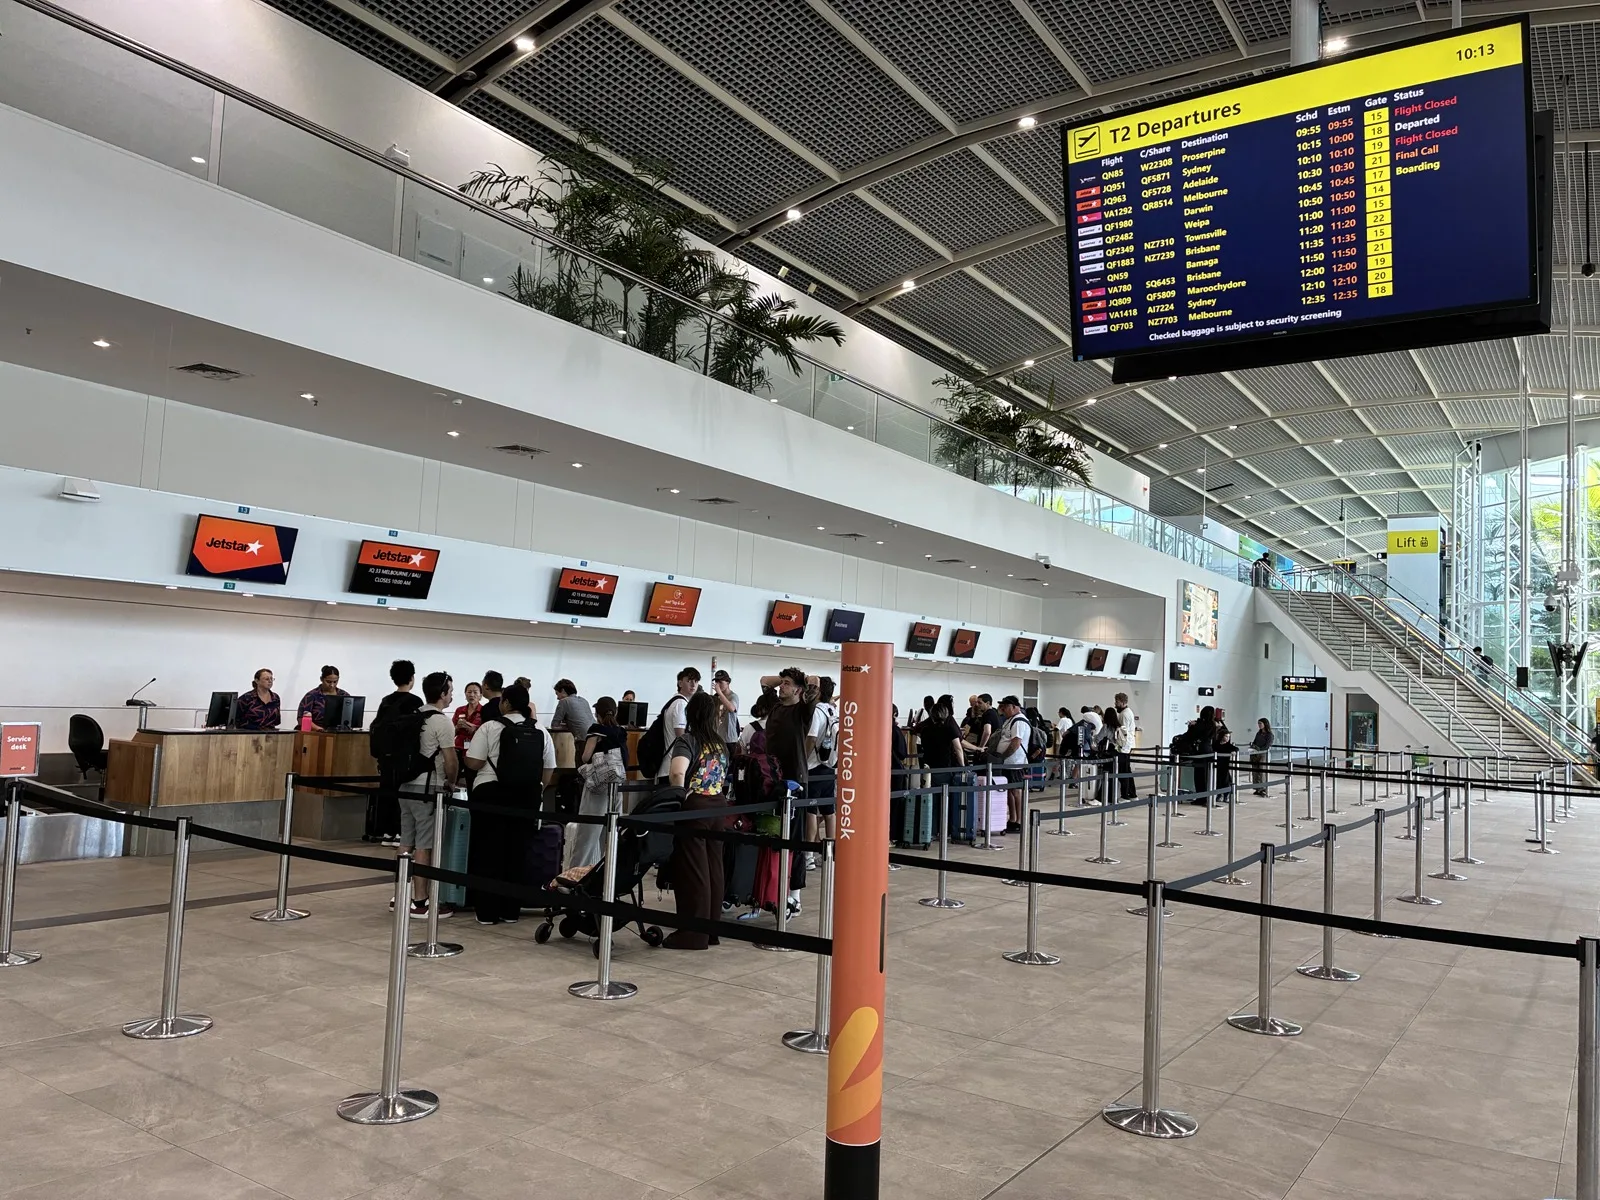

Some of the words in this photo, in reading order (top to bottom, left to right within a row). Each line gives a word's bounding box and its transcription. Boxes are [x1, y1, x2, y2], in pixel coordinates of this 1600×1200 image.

[1456, 43, 1495, 61] 10:13
[1101, 155, 1123, 167] Flight
[1139, 145, 1170, 158] C/Share
[1181, 132, 1228, 148] Destination
[1295, 110, 1317, 122] Schd
[1327, 104, 1350, 115] Estm
[1364, 96, 1387, 107] Gate
[1393, 88, 1424, 101] Status
[1101, 168, 1123, 180] QN85
[1140, 157, 1172, 171] W22308
[1181, 147, 1225, 162] Proserpine
[1295, 124, 1321, 137] 09:55
[1327, 117, 1353, 130] 09:55
[1371, 112, 1382, 121] 15
[1394, 103, 1422, 117] Flight
[1424, 96, 1457, 111] Closed
[1110, 126, 1131, 143] T2
[1137, 103, 1241, 138] Departures
[1102, 181, 1125, 193] JQ951
[1140, 171, 1169, 184] QF5871
[1182, 163, 1212, 177] Sydney
[1296, 138, 1321, 151] 10:15
[1328, 132, 1354, 144] 10:00
[1371, 126, 1382, 136] 18
[1394, 114, 1440, 131] Departed
[1102, 194, 1126, 205] JQ963
[1141, 184, 1171, 197] QF5728
[1182, 175, 1218, 189] Adelaide
[1297, 153, 1321, 165] 10:10
[1328, 146, 1354, 158] 10:10
[1372, 141, 1383, 150] 19
[1395, 133, 1423, 147] Flight
[1425, 126, 1458, 140] Closed
[1103, 206, 1132, 218] VA1292
[1141, 197, 1173, 211] QR8514
[1183, 188, 1228, 202] Melbourne
[1297, 167, 1322, 179] 10:30
[1329, 161, 1354, 173] 10:30
[1372, 155, 1383, 164] 21
[1395, 148, 1418, 161] Final
[1420, 144, 1439, 156] Call
[1104, 219, 1133, 231] QF1980
[1183, 203, 1213, 216] Darwin
[1297, 181, 1322, 193] 10:45
[1329, 175, 1354, 187] 10:45
[1372, 170, 1383, 179] 17
[1395, 161, 1440, 175] Boarding
[1104, 231, 1133, 244] QF2482
[1183, 218, 1209, 230] Weipa
[1298, 196, 1323, 207] 10:50
[1330, 190, 1355, 201] 10:50
[1373, 184, 1384, 194] 14
[1105, 244, 1134, 256] QF2349
[1143, 237, 1174, 249] NZ7310
[1184, 228, 1226, 242] Townsville
[1298, 210, 1323, 221] 11:00
[1330, 204, 1355, 215] 11:00
[1373, 199, 1384, 208] 15
[1106, 257, 1134, 269] QF1883
[1144, 250, 1175, 262] NZ7239
[1185, 244, 1220, 255] Brisbane
[1299, 224, 1323, 235] 11:20
[1330, 218, 1356, 230] 11:20
[1374, 213, 1385, 222] 22
[1106, 271, 1128, 281] QN59
[1186, 257, 1218, 269] Bamaga
[1299, 238, 1324, 249] 11:35
[1331, 233, 1356, 244] 11:35
[1374, 228, 1385, 237] 15
[1107, 283, 1131, 293] VA780
[1145, 276, 1175, 288] SQ6453
[1186, 271, 1221, 281] Brisbane
[1299, 252, 1324, 263] 11:50
[1331, 247, 1356, 258] 11:50
[1374, 242, 1385, 252] 21
[1108, 296, 1131, 306] JQ809
[1146, 289, 1175, 301] QF5809
[1187, 280, 1246, 294] Maroochydore
[1300, 266, 1324, 277] 12:00
[1332, 261, 1356, 272] 12:00
[1375, 257, 1386, 266] 19
[1108, 308, 1137, 318] VA1418
[1146, 303, 1174, 313] AI7224
[1187, 297, 1216, 309] Sydney
[1300, 280, 1325, 291] 12:10
[1332, 275, 1357, 286] 12:10
[1375, 271, 1386, 280] 20
[1109, 321, 1133, 331] QF703
[1147, 315, 1177, 326] NZ7703
[1188, 309, 1232, 320] Melbourne
[1301, 294, 1325, 304] 12:35
[1332, 289, 1357, 300] 12:35
[1375, 286, 1386, 295] 18
[1148, 329, 1180, 340] Checked
[1181, 325, 1215, 338] baggage
[1216, 323, 1223, 332] is
[1224, 320, 1253, 332] subject
[1254, 319, 1264, 328] to
[1265, 314, 1299, 326] security
[1300, 309, 1342, 322] screening
[206, 537, 249, 552] Jetstar
[373, 549, 411, 563] Jetstar
[1397, 537, 1416, 548] Lift
[382, 569, 408, 577] MELBOURNE
[570, 575, 598, 588] Jetstar
[842, 701, 858, 781] Service
[840, 788, 855, 840] Desk
